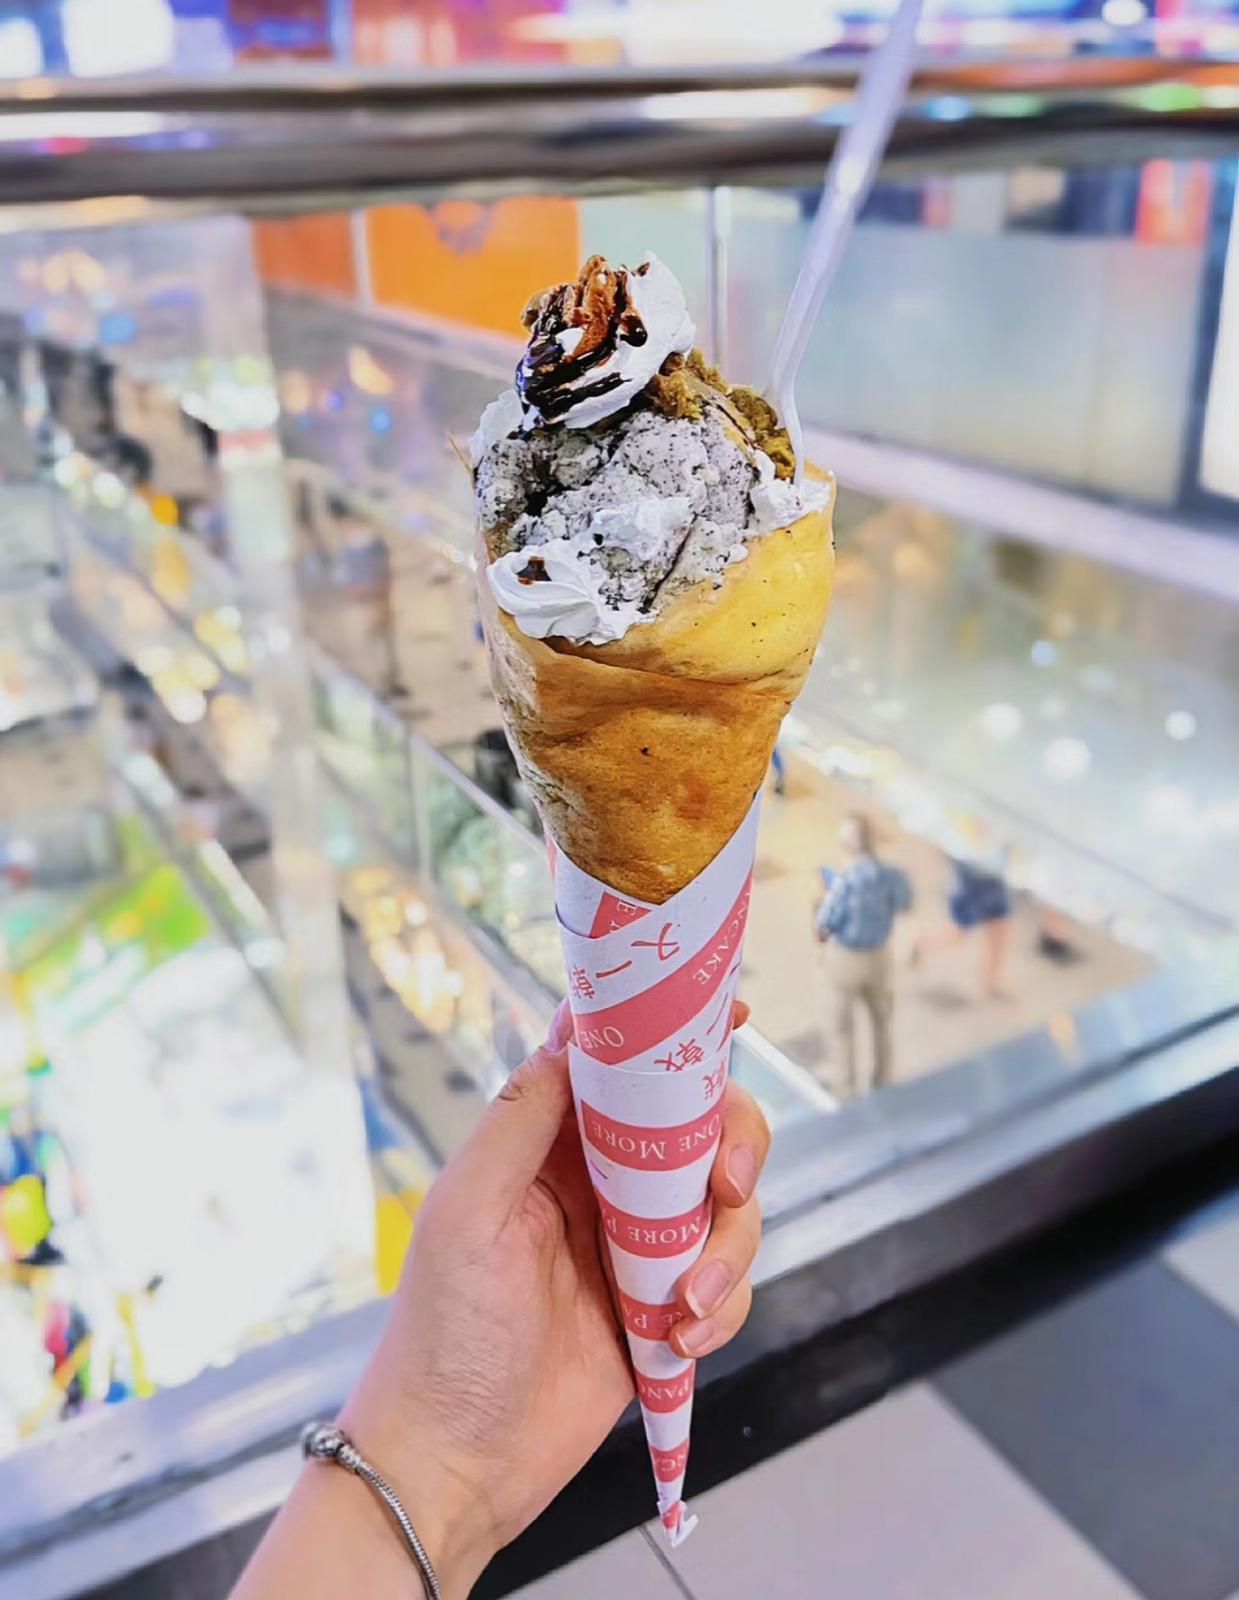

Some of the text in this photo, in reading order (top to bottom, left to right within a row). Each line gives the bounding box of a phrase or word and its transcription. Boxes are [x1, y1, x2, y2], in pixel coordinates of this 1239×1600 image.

[580, 1026, 624, 1049] ONE
[592, 1113, 720, 1160] ONE MORE
[627, 1216, 702, 1246] MORE
